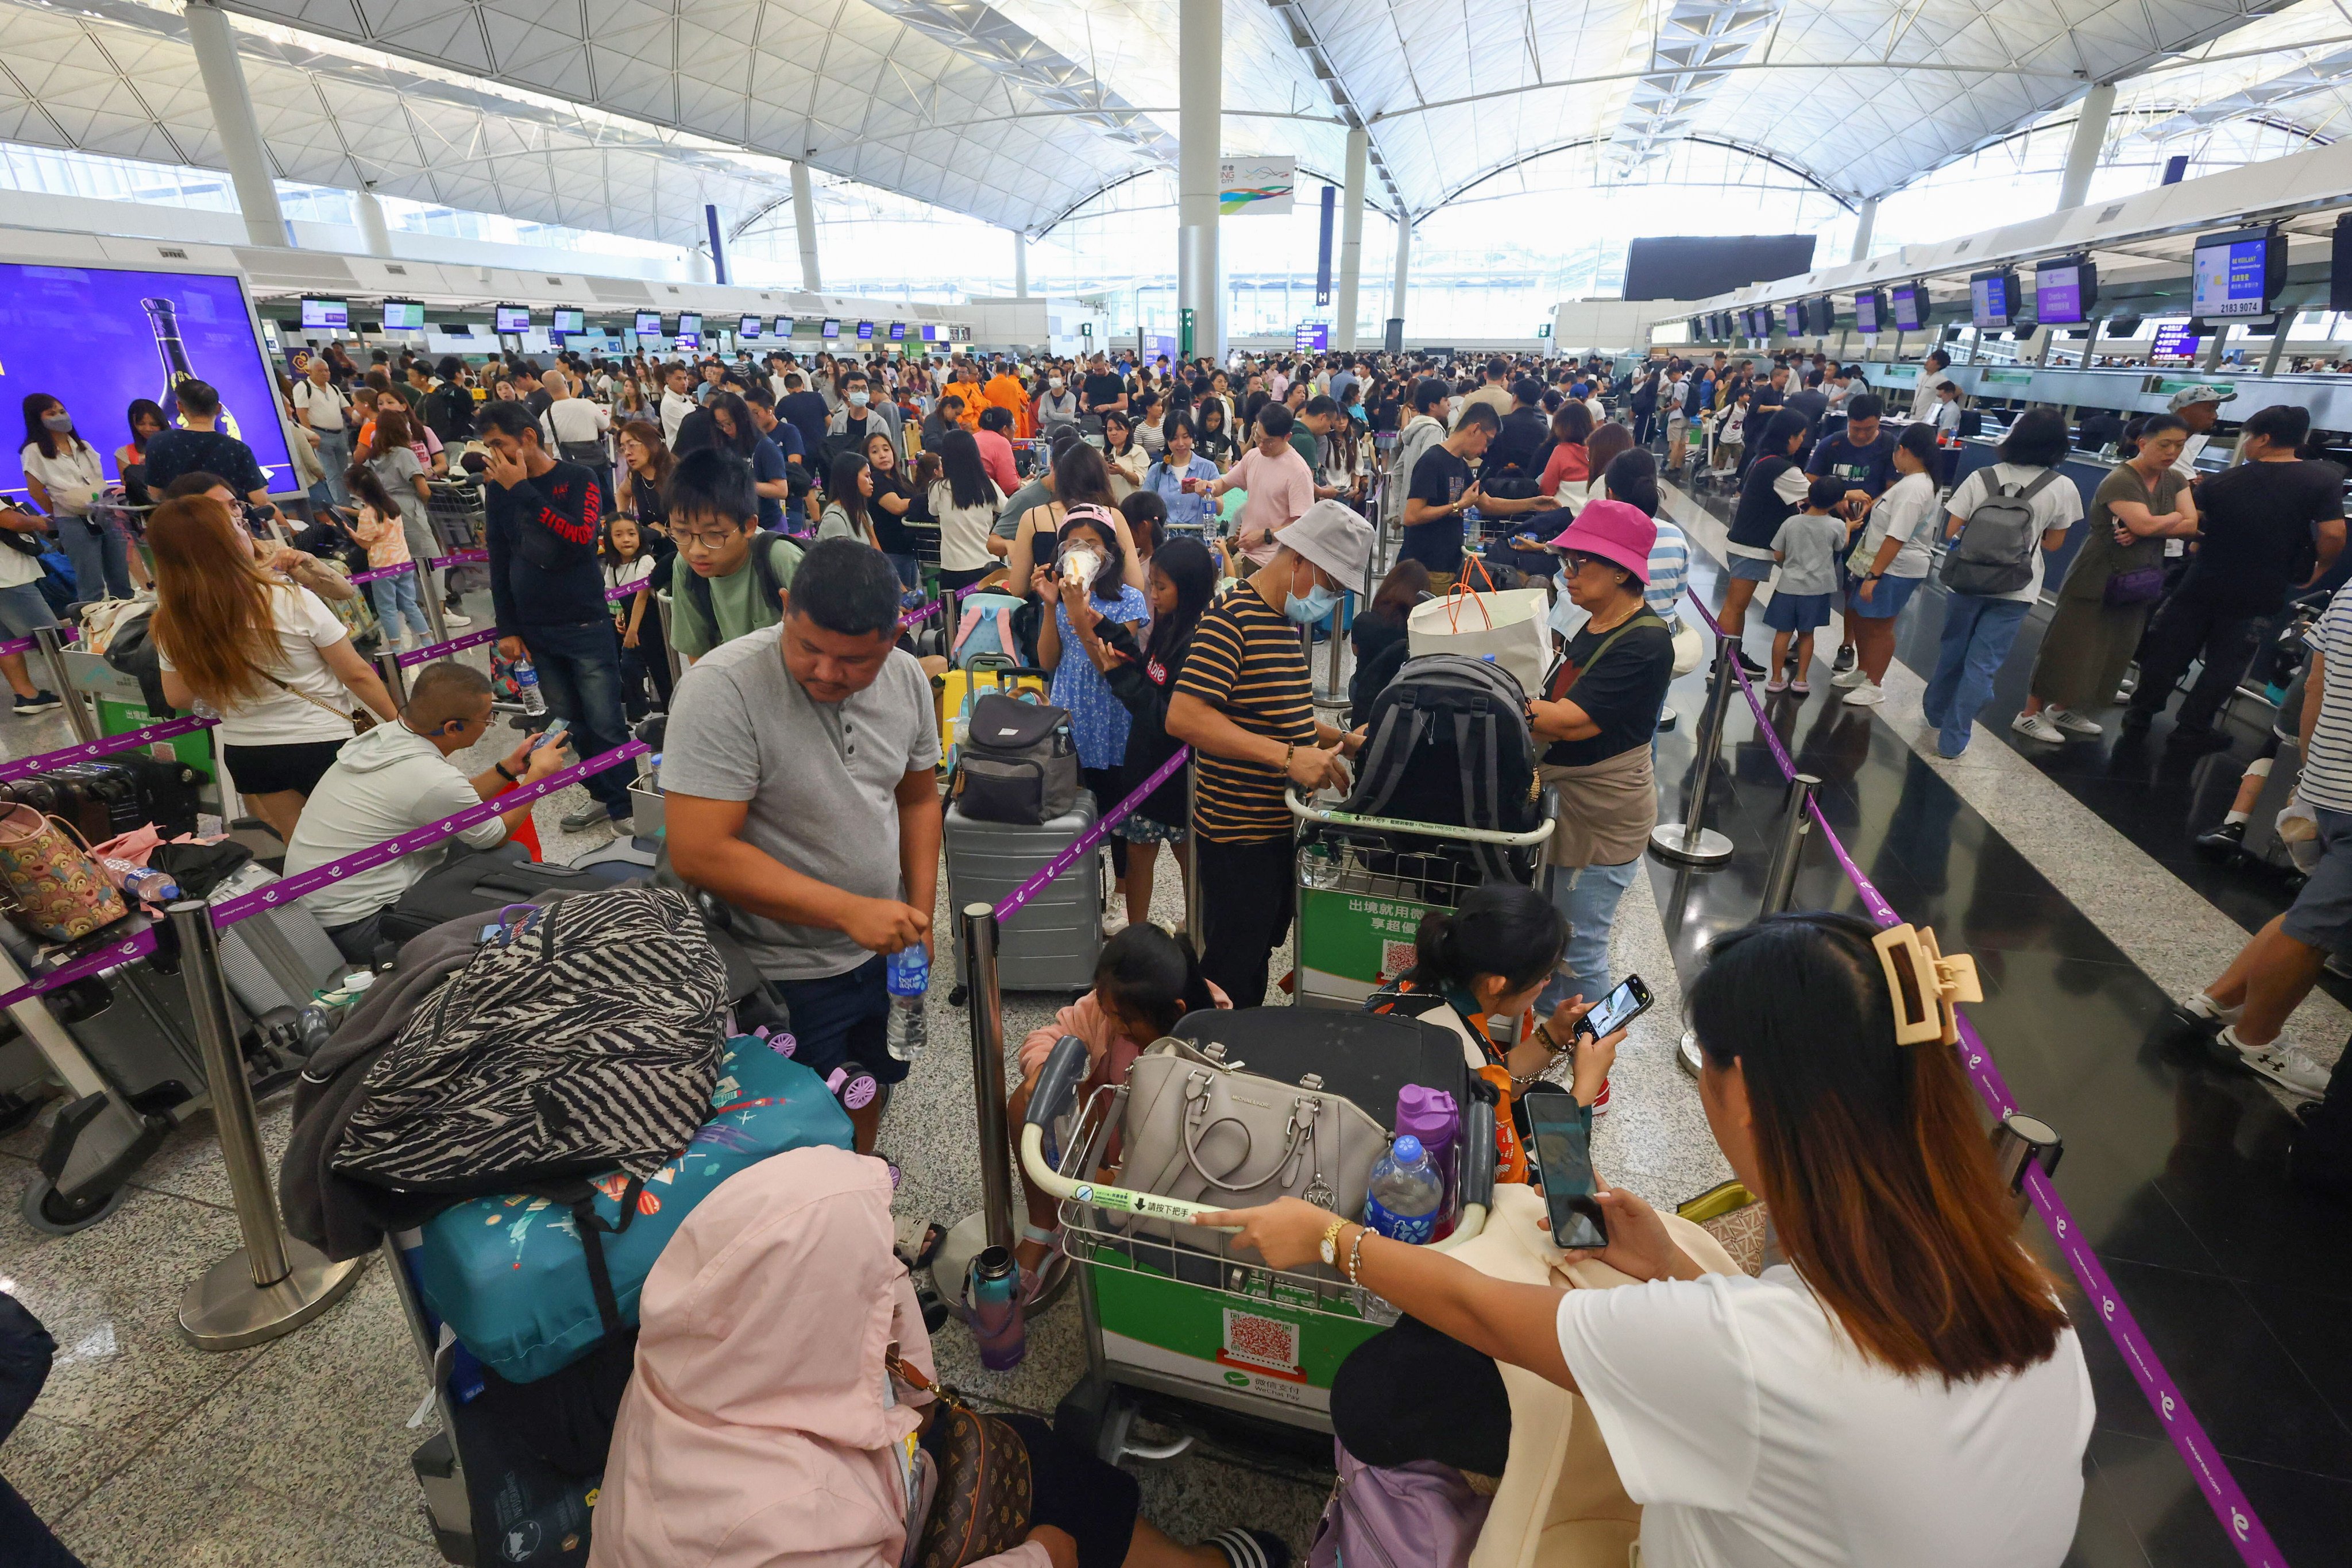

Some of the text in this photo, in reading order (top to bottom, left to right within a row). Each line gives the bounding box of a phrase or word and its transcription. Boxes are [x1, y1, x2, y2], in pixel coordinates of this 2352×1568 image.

[1319, 292, 1327, 303] H
[2221, 302, 2257, 313] 2183 9074
[537, 481, 601, 545] ABERCROMBIE
[1231, 1094, 1272, 1109] MICHAEL KORS
[1148, 1202, 1189, 1217] 請按下把手
[1254, 1378, 1299, 1395] 微信支付
[1254, 1385, 1300, 1401] WeChat Pay
[2185, 1436, 2222, 1496] hkexpress.com
